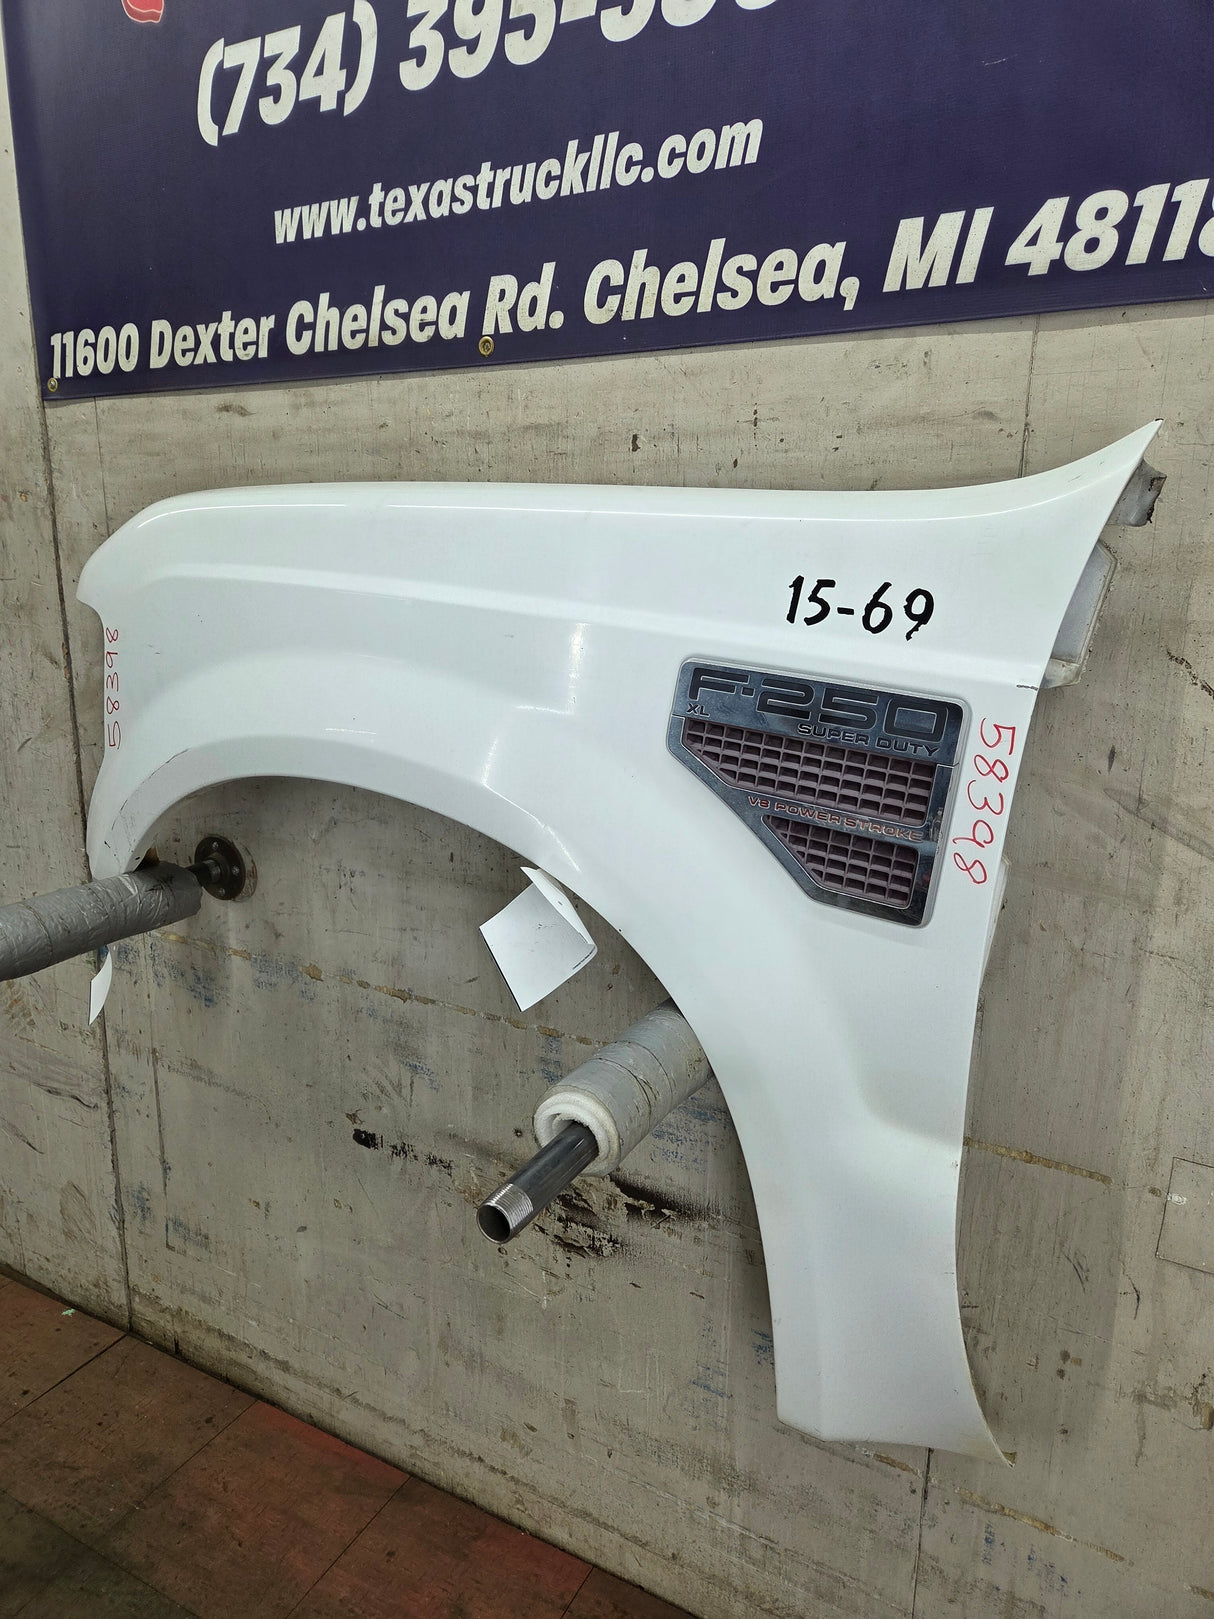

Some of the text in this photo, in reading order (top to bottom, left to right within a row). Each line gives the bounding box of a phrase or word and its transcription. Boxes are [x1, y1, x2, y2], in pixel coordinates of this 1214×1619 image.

[198, 0, 378, 146] (734)
[274, 119, 763, 244] www.texastruckllc.com
[50, 322, 139, 379] 11600
[150, 311, 275, 369] Dexter
[286, 285, 470, 355] Chelsea
[483, 262, 564, 335] Rd.
[584, 237, 861, 324] Chelsea,
[882, 206, 994, 293] MI
[786, 575, 935, 641] 15-69
[105, 627, 121, 750] 58398
[686, 703, 710, 717] XL
[688, 667, 949, 742] F-250
[797, 723, 941, 757] SUPER DUTY
[748, 796, 770, 809] V8
[952, 717, 1016, 885] 58398
